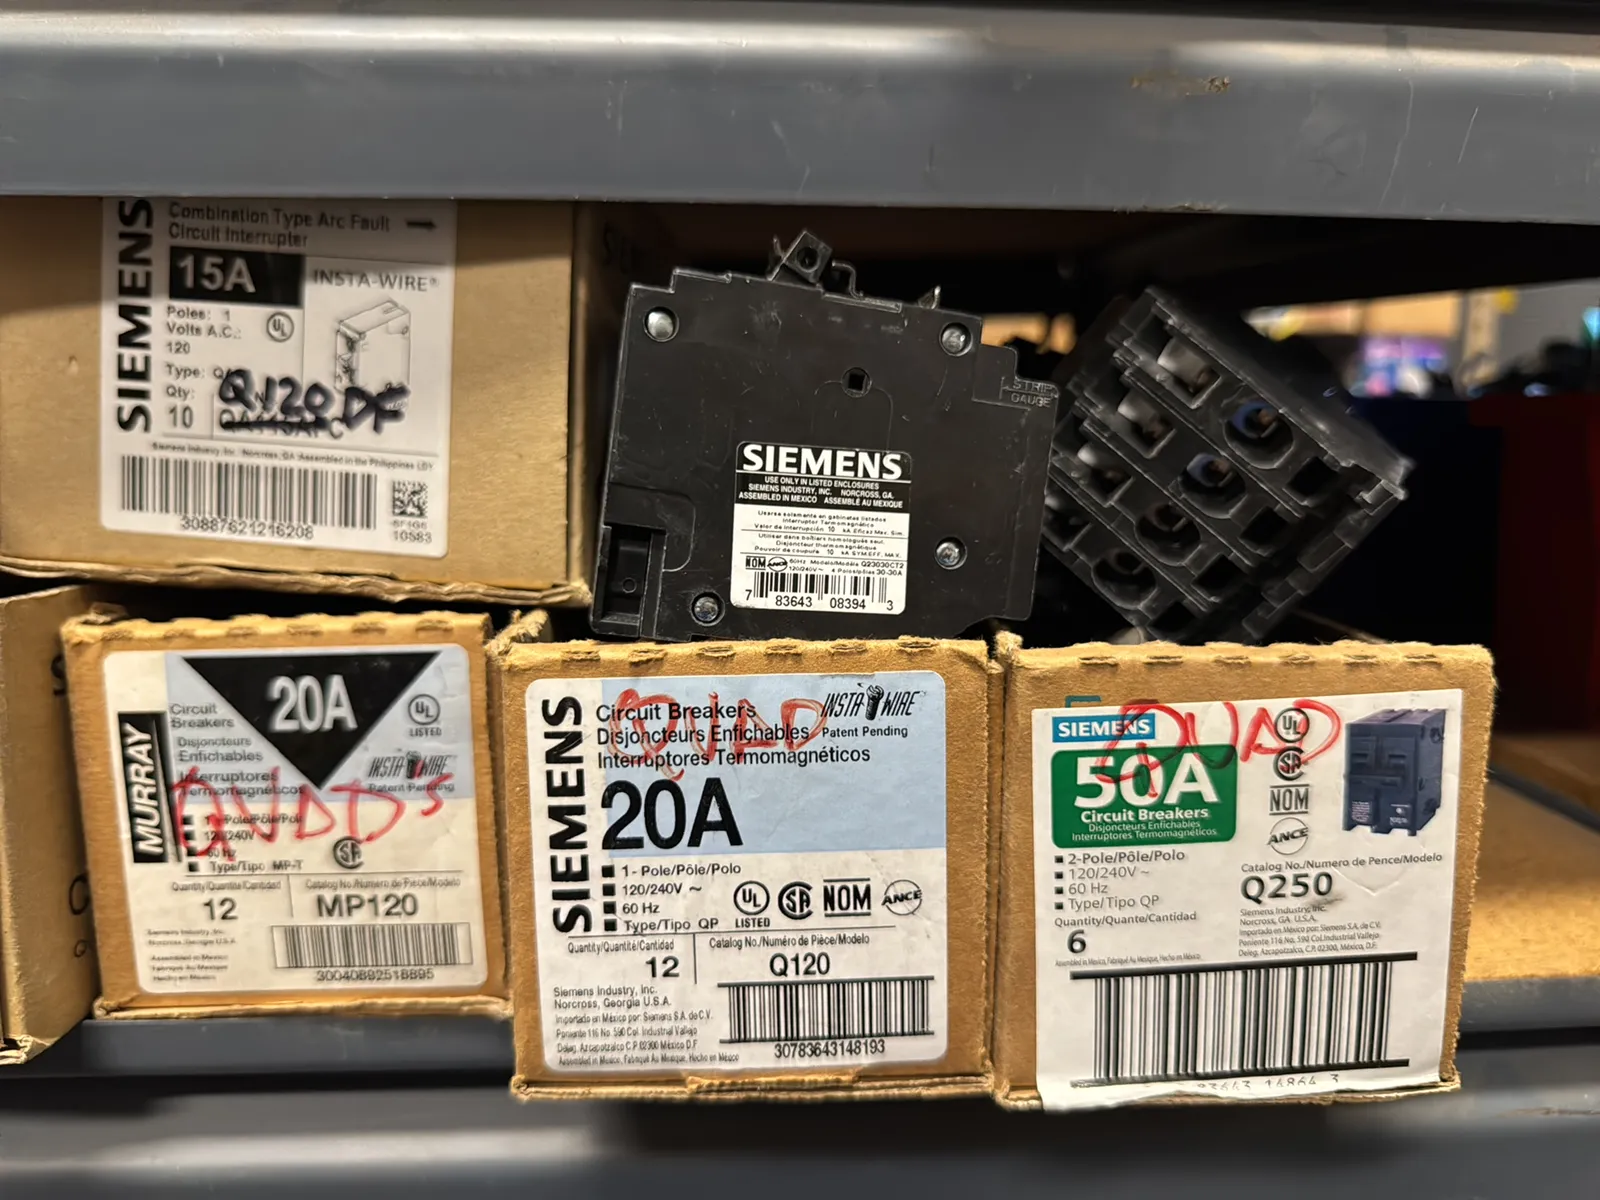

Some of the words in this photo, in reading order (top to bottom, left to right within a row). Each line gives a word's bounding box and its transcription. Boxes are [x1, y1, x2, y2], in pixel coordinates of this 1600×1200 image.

[168, 202, 269, 225] Combination
[273, 207, 313, 229] Type
[317, 212, 346, 230] Arc
[350, 213, 391, 233] Fault
[168, 222, 221, 243] Circuit
[225, 229, 308, 248] Interrupter
[177, 252, 256, 293] 15A
[117, 197, 153, 433] SIEMENS
[167, 304, 212, 321] Poles:
[166, 321, 202, 337] Volts
[165, 340, 191, 355] 120
[165, 361, 206, 381] Type:
[166, 384, 196, 402] Qty:
[1012, 379, 1053, 394] STRIP
[1010, 392, 1052, 408] GAUGE
[168, 404, 195, 430] 10
[742, 443, 903, 481] SIEMENS
[748, 482, 780, 493] SIEMENS
[780, 484, 818, 496] INDUSTRY,
[840, 488, 881, 500] NORCROSS,
[764, 475, 779, 484] USE
[780, 477, 800, 486] ONLY
[801, 477, 808, 486] IN
[808, 478, 833, 488] LISTED
[833, 480, 880, 491] ENCLOSURES
[738, 491, 781, 502] ASSEMBLED
[782, 493, 790, 502] IN
[790, 494, 818, 504] MEXICO
[861, 498, 872, 507] AU
[872, 499, 904, 510] MEXIQUE
[860, 560, 905, 570] Q23030CT2
[744, 589, 753, 602] 7
[774, 595, 813, 608] 83643
[829, 597, 867, 610] 08394
[886, 599, 895, 612] 3
[170, 703, 218, 716] Circuit
[268, 674, 358, 733] 20A
[595, 703, 662, 722] Circuit
[668, 700, 757, 720] Breakers
[820, 691, 865, 719] INSTA
[880, 690, 921, 717] WIRE
[170, 717, 235, 729] Breakers
[408, 727, 442, 738] LISTED
[822, 725, 859, 738] Patent
[862, 724, 908, 738] Pending
[1057, 718, 1151, 738] SIEMENS
[1282, 714, 1303, 736] UL
[177, 736, 252, 749] Disjoncteurs
[597, 727, 706, 748] Disjoncteurs
[711, 723, 810, 743] Enfichables
[606, 687, 829, 783] QUAD
[178, 749, 264, 763] Enfichables
[1094, 698, 1342, 798] QUAD
[598, 751, 710, 770] Interruptores
[714, 746, 871, 768] Termomagnéticos
[120, 720, 164, 856] MURRAY
[368, 782, 406, 794] Patent
[1073, 751, 1221, 809] 50A
[1268, 786, 1310, 813] NOM
[541, 695, 593, 934] SIEMENS
[600, 776, 744, 850] 20A
[1080, 808, 1135, 825] Circuit
[1137, 806, 1210, 823] Breakers
[1071, 831, 1133, 842] Interruptores
[1088, 821, 1146, 833] Disjoncteurs
[1266, 826, 1310, 846] ANCE
[1067, 849, 1186, 866] 2-Pole/Pôle/Polo
[1240, 861, 1283, 875] Catalog
[1284, 858, 1350, 872] No./Numero
[1351, 857, 1367, 867] de
[1367, 853, 1444, 867] Pence/Modelo
[641, 862, 742, 877] Pole/Pôle/Polo
[1068, 865, 1137, 881] 120/240V
[622, 882, 683, 896] 120/240V
[741, 886, 762, 908] UL
[822, 883, 872, 912] NOM
[881, 889, 923, 907] ANCE
[1068, 882, 1087, 895] 60
[1090, 882, 1109, 895] Hz
[1240, 871, 1334, 906] Q250
[203, 897, 239, 921] 12
[316, 892, 419, 918] MP120
[622, 902, 640, 914] 60
[642, 901, 661, 914] Hz
[1139, 894, 1161, 909] QP
[1054, 911, 1198, 929] Quantity/Quante/Cantidad
[1239, 907, 1275, 918] Siemens
[624, 918, 691, 936] Type/Tipo
[697, 917, 719, 930] QP
[735, 917, 771, 929] LISTED
[708, 935, 743, 951] Catalog
[798, 934, 809, 946] de
[1066, 928, 1087, 955] 6
[645, 955, 680, 978] 12
[769, 951, 831, 978] Q120
[553, 985, 595, 998] Siemens
[597, 985, 639, 1000] Industry,
[640, 983, 659, 995] Inc.
[553, 997, 601, 1011] Norcross,
[602, 996, 641, 1011] Georgia
[774, 1038, 886, 1059] 30783643148193
